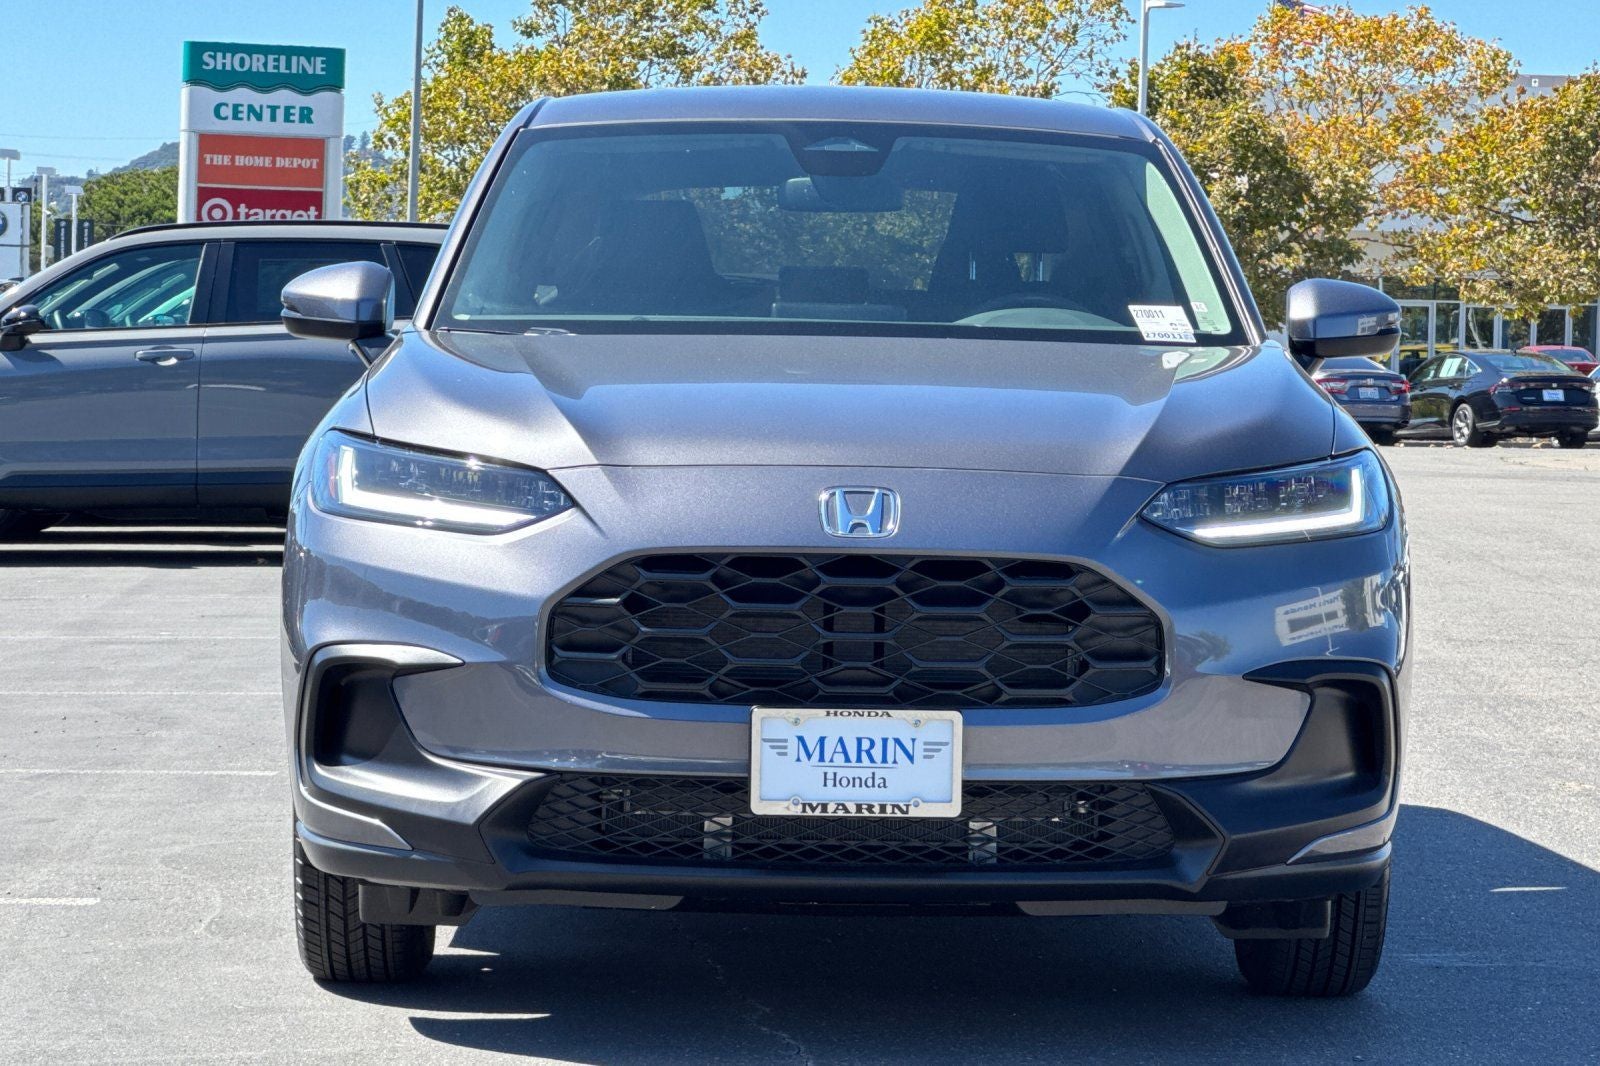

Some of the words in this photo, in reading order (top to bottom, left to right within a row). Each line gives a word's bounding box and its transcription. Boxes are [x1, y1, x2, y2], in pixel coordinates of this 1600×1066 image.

[202, 51, 327, 75] SHORELINE
[213, 102, 314, 124] CENTER
[203, 154, 231, 166] THE
[234, 155, 272, 168] HOME
[275, 156, 319, 169] DEPOT
[1133, 309, 1165, 319] 270011
[1145, 332, 1184, 340] 270011
[825, 710, 893, 718] HONDA
[795, 735, 917, 765] MARIN
[822, 771, 888, 789] Honda
[801, 802, 912, 815] MARIN
